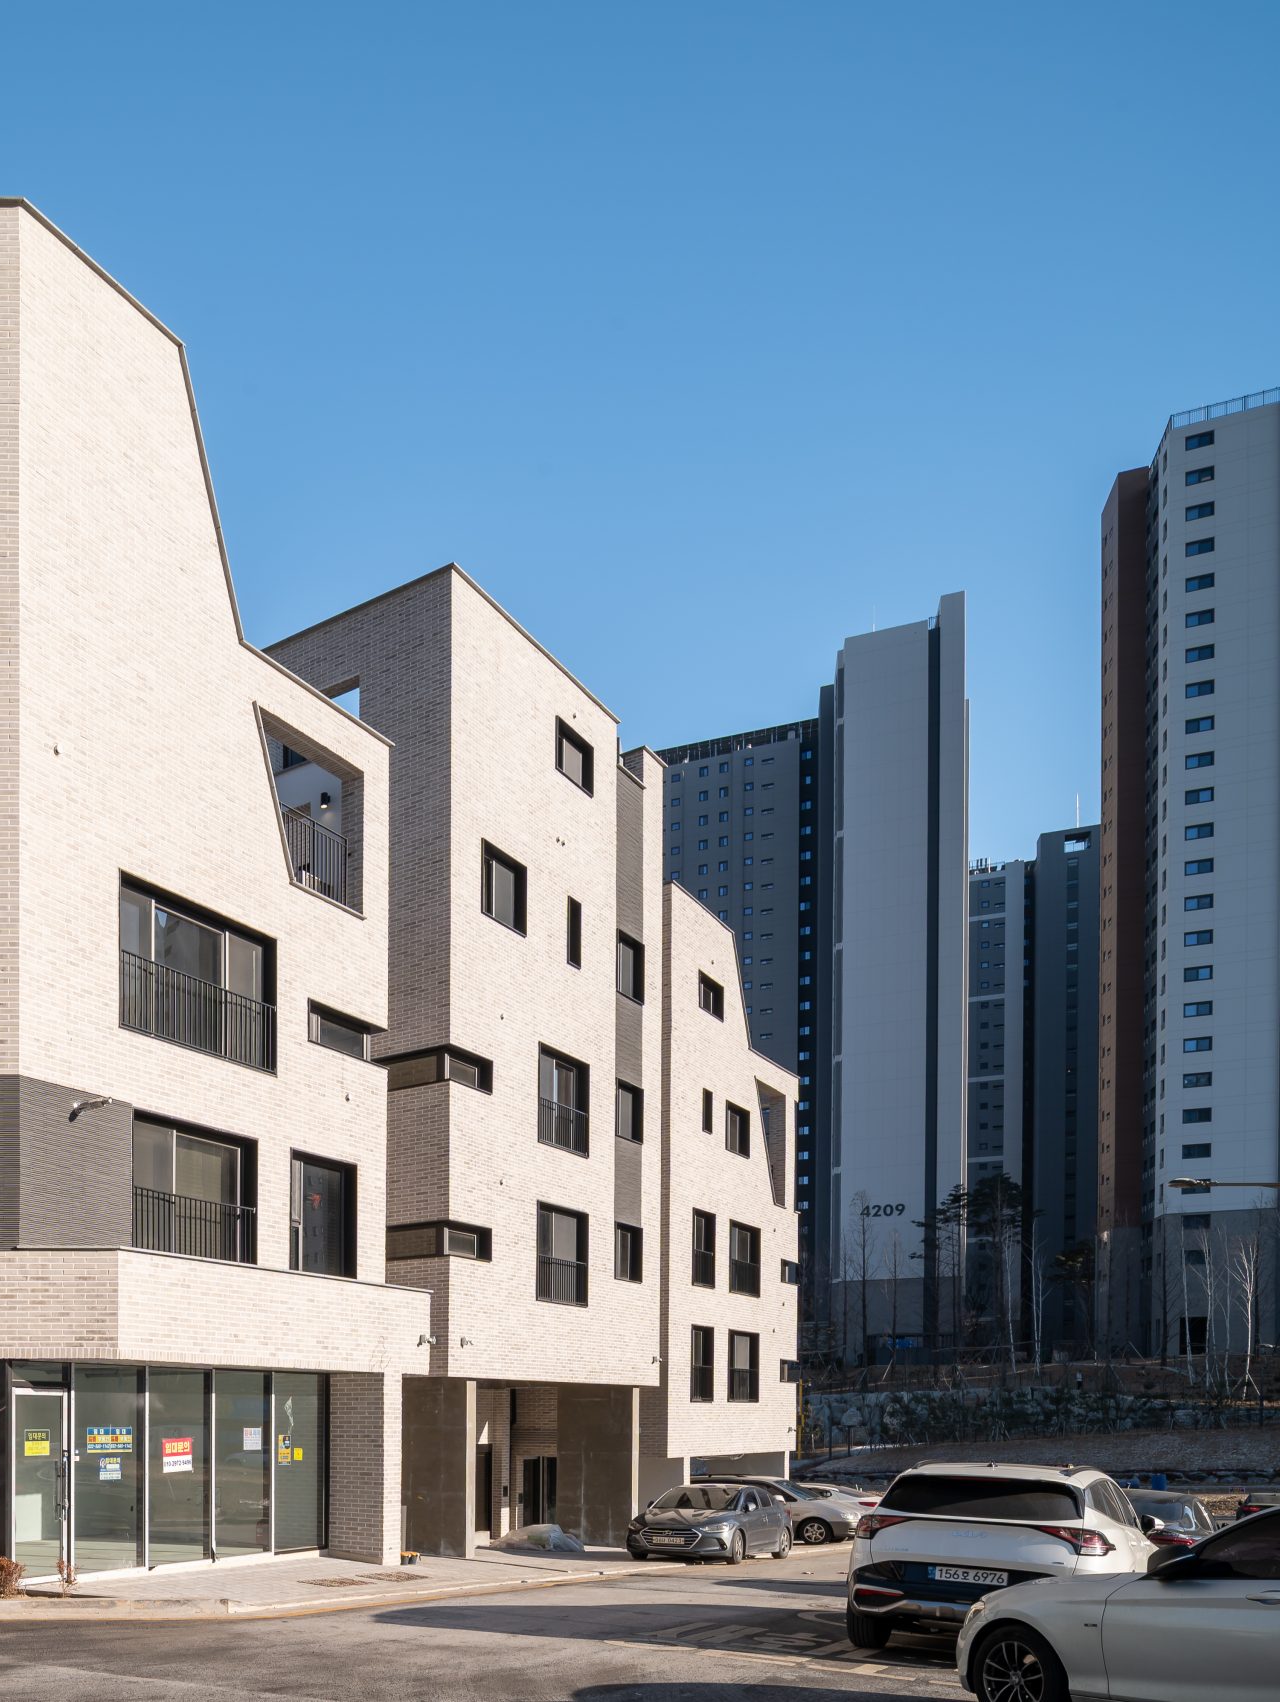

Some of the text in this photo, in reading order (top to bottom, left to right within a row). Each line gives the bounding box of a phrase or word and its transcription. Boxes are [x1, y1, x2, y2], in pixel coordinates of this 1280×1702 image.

[860, 1203, 905, 1217] 4209
[28, 1432, 47, 1440] 임대문의
[165, 1441, 190, 1454] 임대문의
[937, 1568, 1005, 1584] 156호 6976
